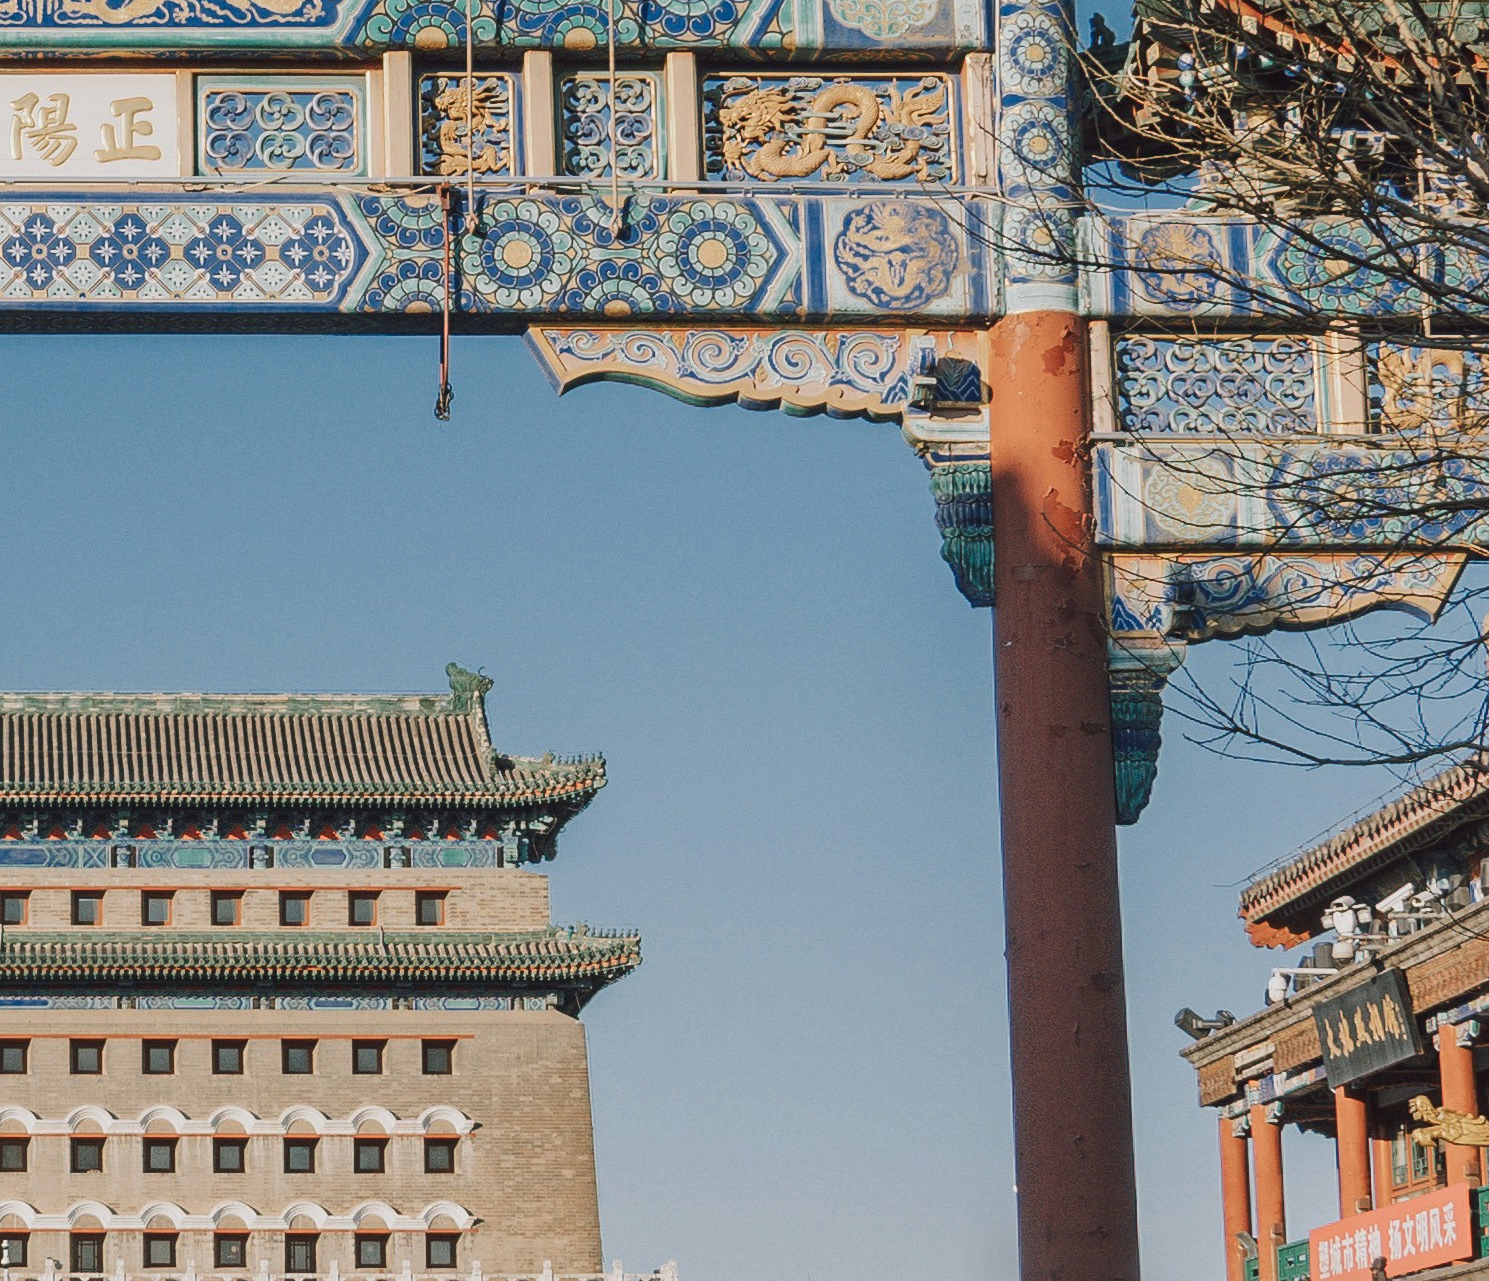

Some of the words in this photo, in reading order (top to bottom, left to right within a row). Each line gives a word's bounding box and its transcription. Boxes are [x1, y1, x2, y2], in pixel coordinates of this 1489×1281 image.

[1388, 1201, 1458, 1261] 扬文明风采
